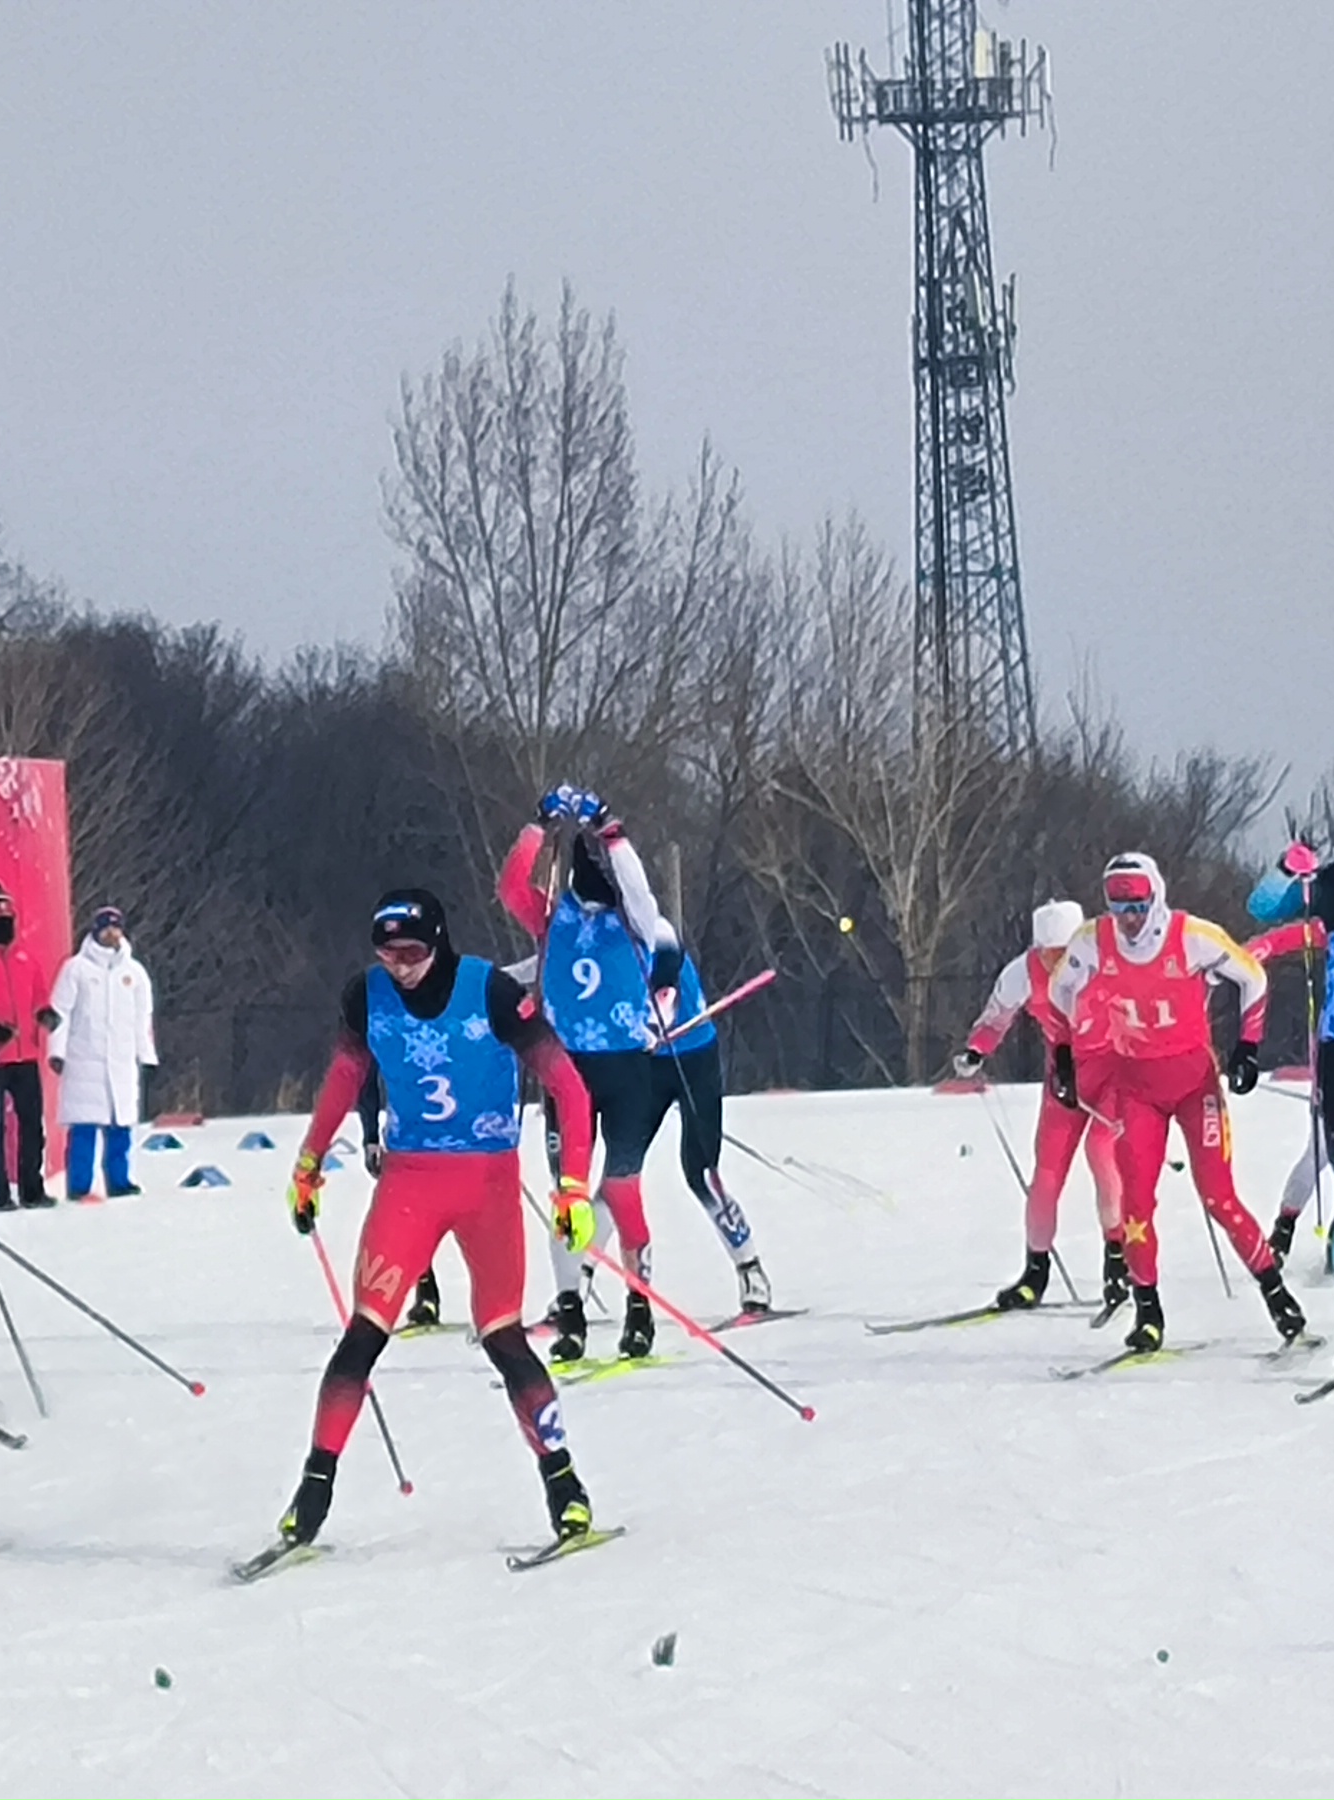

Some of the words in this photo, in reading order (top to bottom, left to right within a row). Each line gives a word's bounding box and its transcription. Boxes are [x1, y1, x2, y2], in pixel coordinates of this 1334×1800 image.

[572, 957, 601, 1001] 9
[1120, 998, 1177, 1030] 11
[416, 1074, 456, 1121] 3
